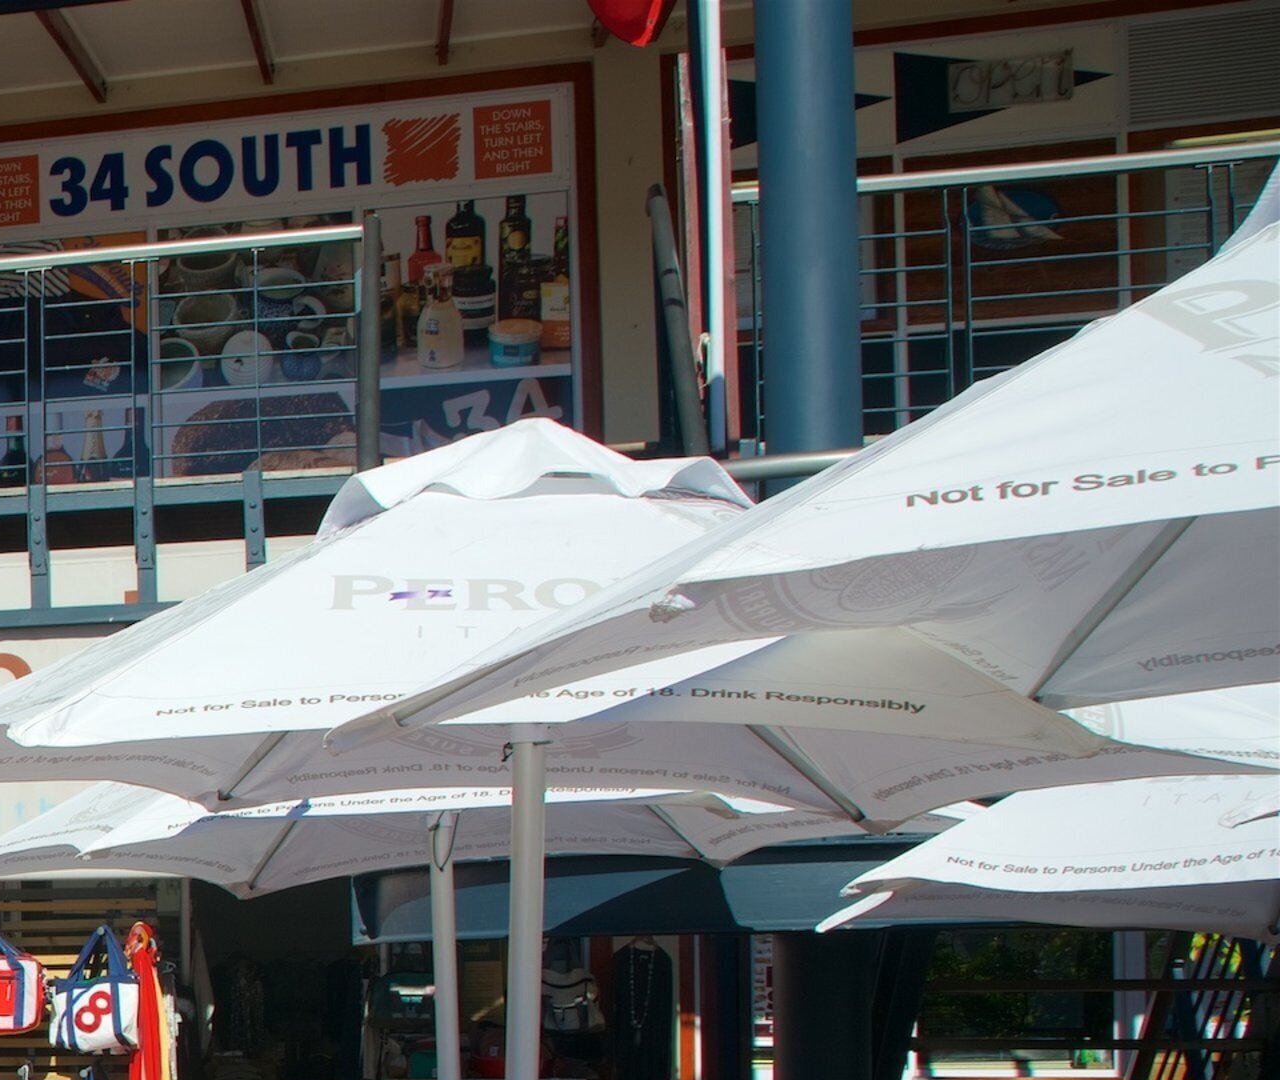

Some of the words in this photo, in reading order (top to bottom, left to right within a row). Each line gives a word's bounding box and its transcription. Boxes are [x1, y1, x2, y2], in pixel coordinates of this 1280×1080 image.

[492, 108, 532, 121] DOWN
[480, 124, 500, 135] THE
[484, 136, 513, 148] TURN
[517, 133, 541, 144] LEFT
[483, 150, 509, 161] AND
[512, 146, 543, 158] THEN
[48, 152, 129, 217] 34
[144, 123, 372, 208] SOUTH
[496, 161, 531, 173] RIGHT
[8, 186, 30, 197] LEFT
[5, 198, 32, 209] THEN
[906, 485, 984, 507] Not
[996, 479, 1059, 499] for
[1072, 468, 1177, 492] Sale
[1192, 461, 1238, 477] to
[156, 706, 195, 716] Not
[203, 703, 234, 712] for
[241, 699, 293, 709] Sale
[300, 696, 322, 705] to
[555, 689, 604, 699] Age
[612, 687, 637, 698] of
[691, 687, 757, 701] Drink
[765, 690, 926, 714] Responsibly
[946, 856, 973, 868] Not
[978, 860, 999, 871] for
[1003, 863, 1038, 874] Sale
[1042, 863, 1058, 875] to
[1062, 863, 1127, 875] Persons
[1131, 860, 1178, 872] Under
[1181, 857, 1207, 868] the
[1211, 852, 1242, 866] Age
[1246, 848, 1265, 860] of
[74, 991, 112, 1034] 8
